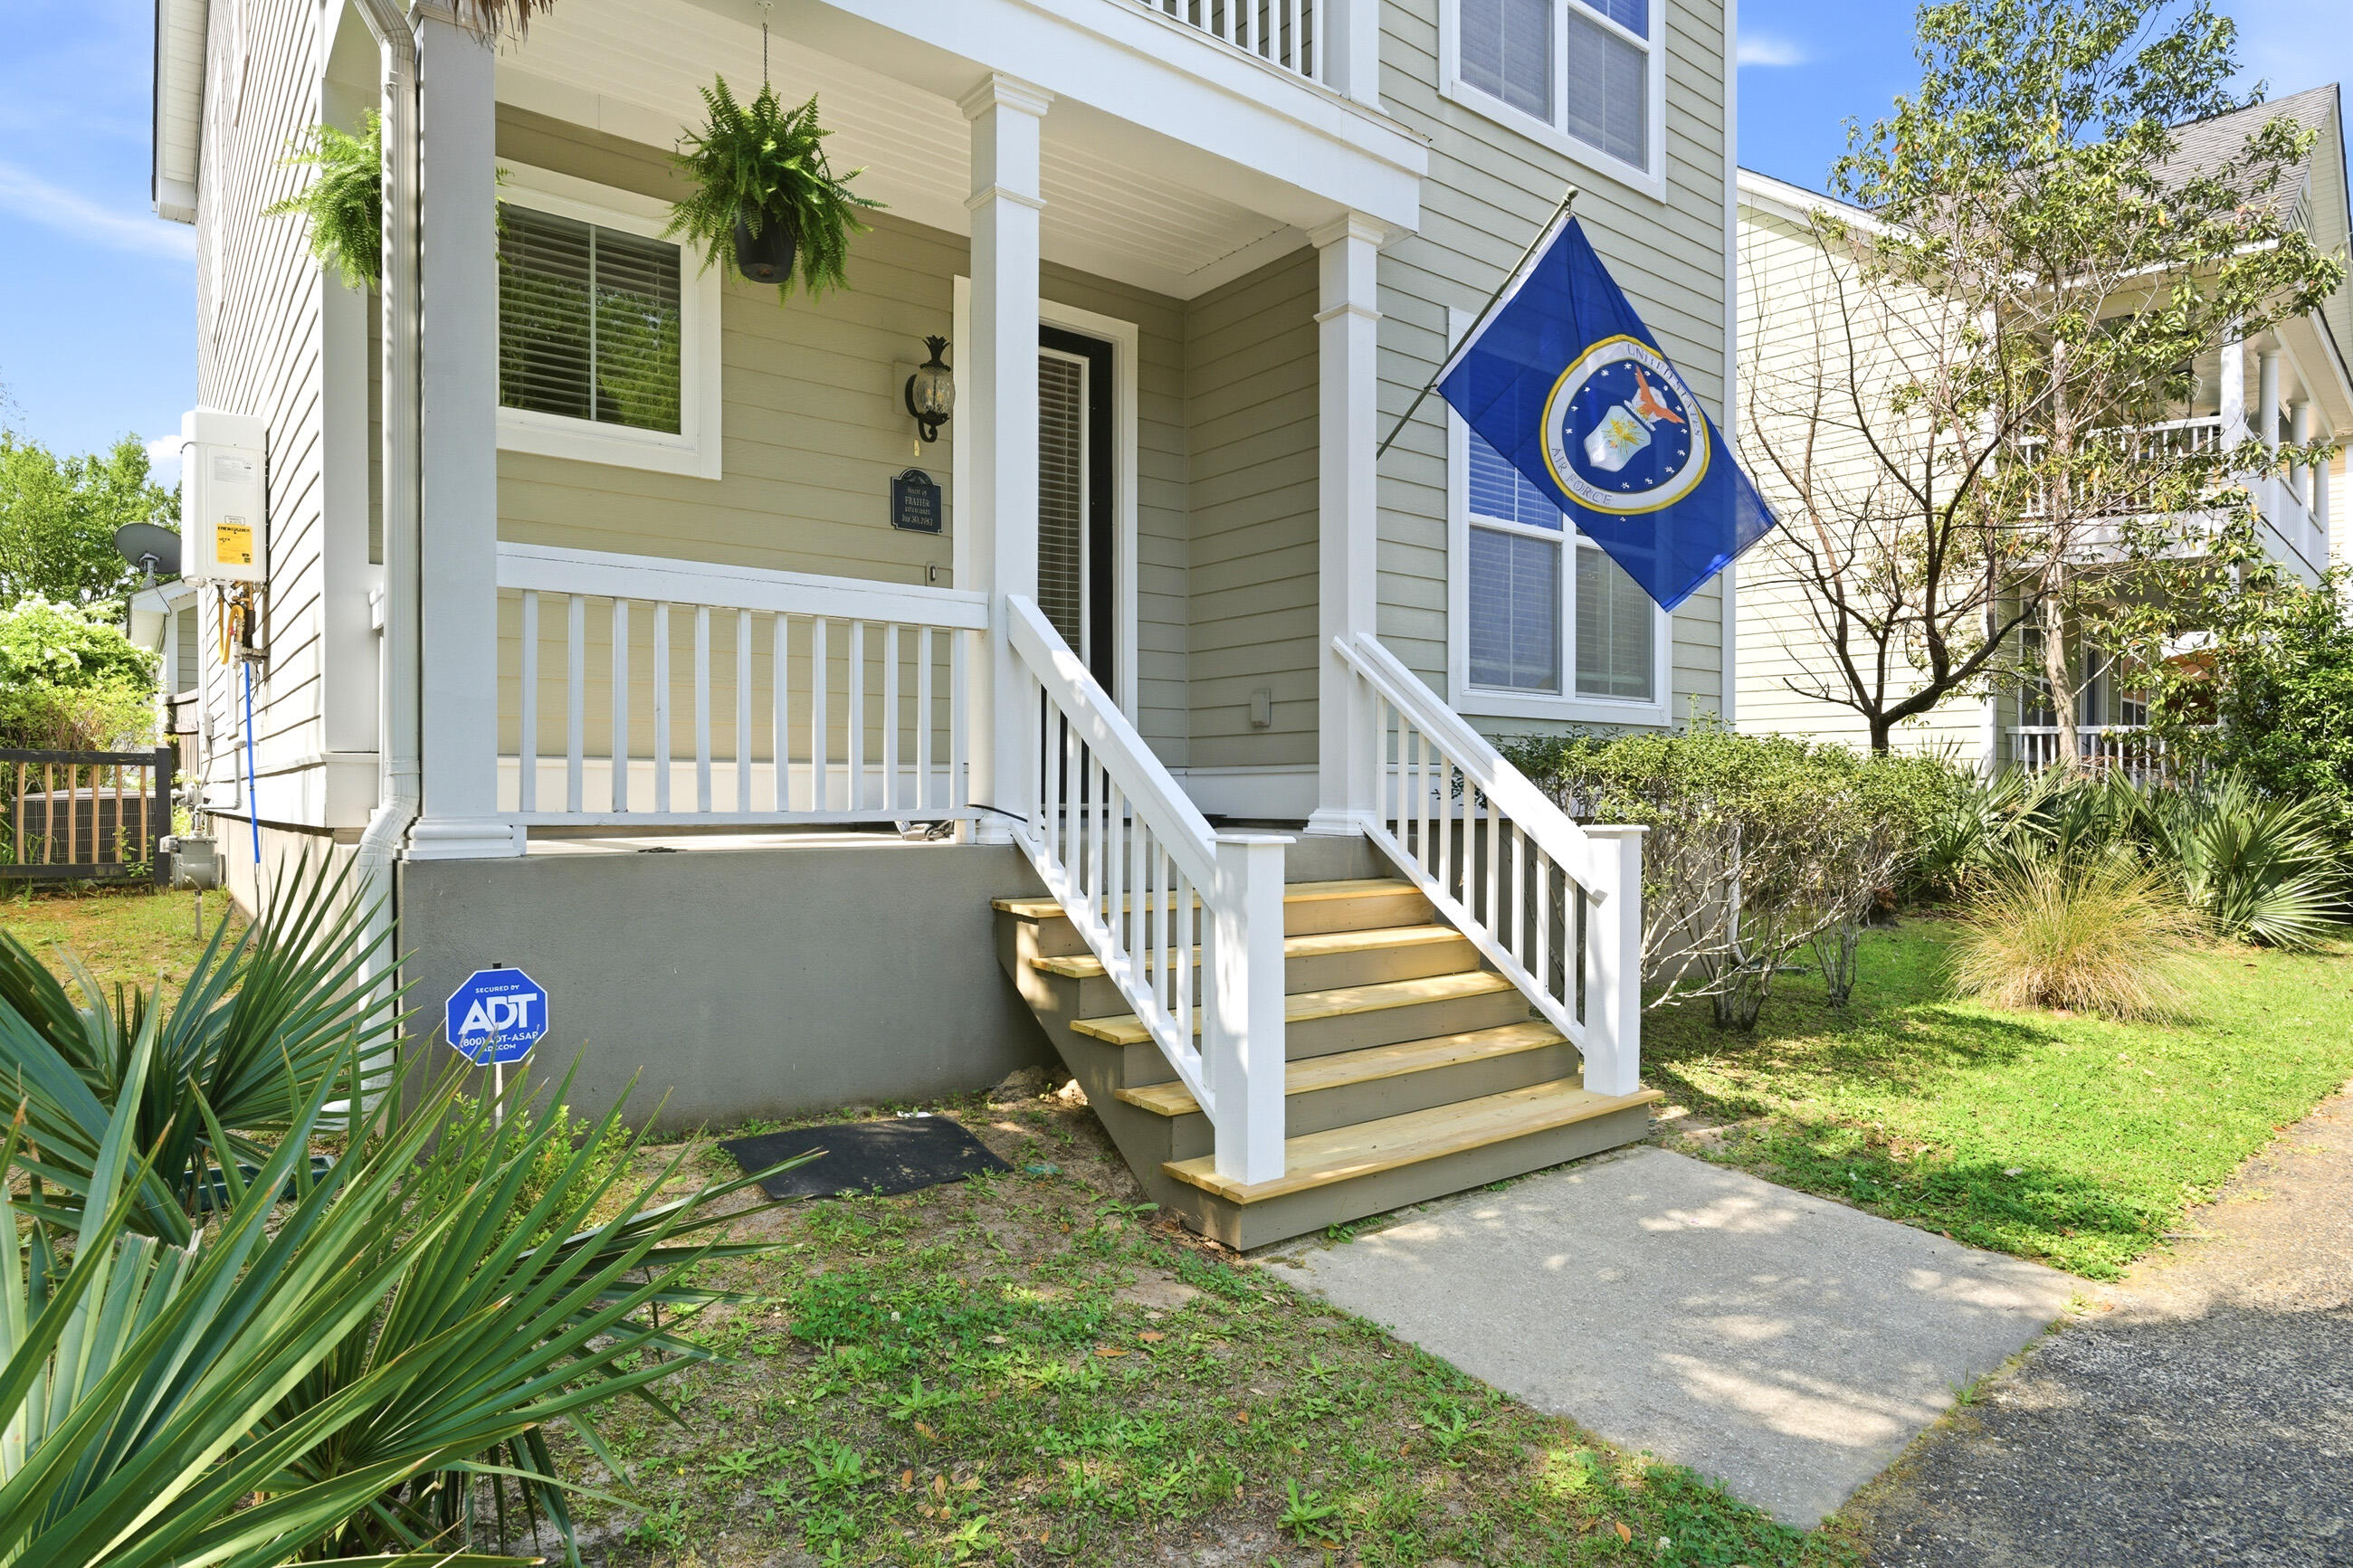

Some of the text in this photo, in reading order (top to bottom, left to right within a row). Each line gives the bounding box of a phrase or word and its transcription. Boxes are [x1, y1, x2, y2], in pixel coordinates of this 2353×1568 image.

[1627, 343, 1702, 437] UNITED STATES
[1551, 448, 1615, 507] AIR FORCE
[475, 985, 509, 993] SECURED
[458, 993, 538, 1035] ADT
[484, 1043, 516, 1052] AD.COM
